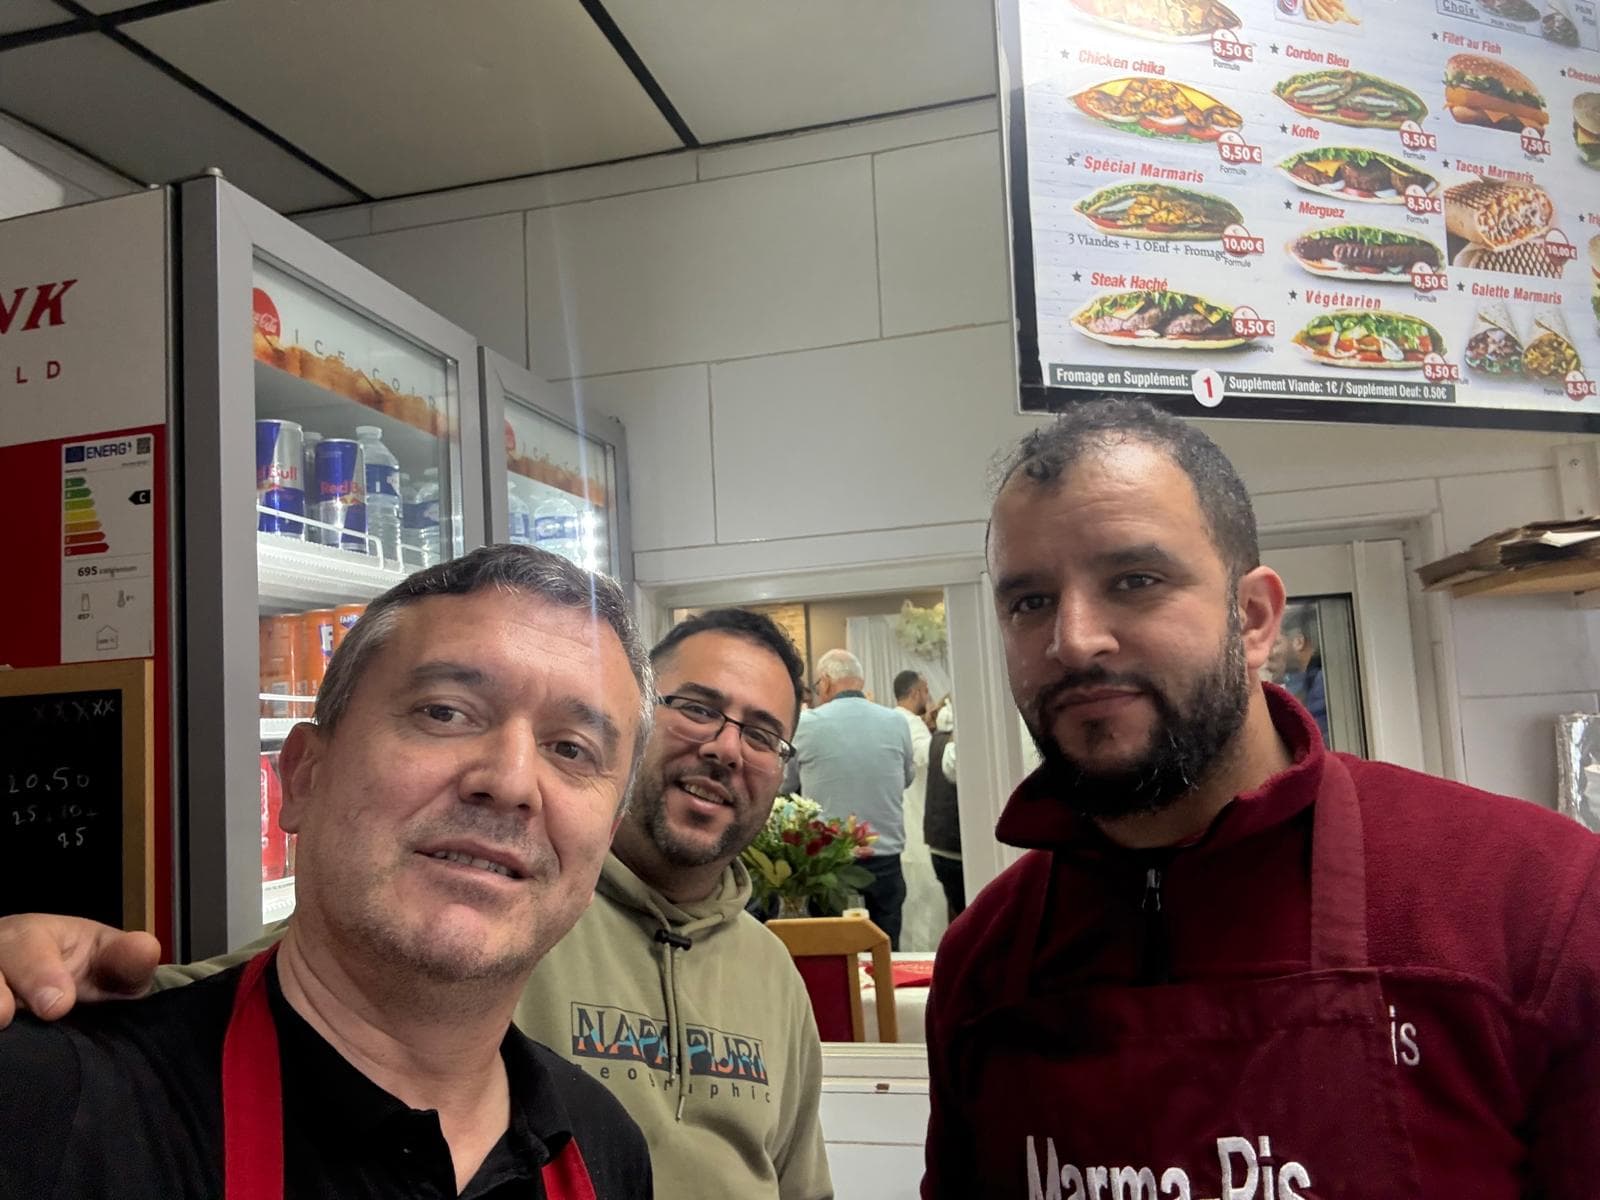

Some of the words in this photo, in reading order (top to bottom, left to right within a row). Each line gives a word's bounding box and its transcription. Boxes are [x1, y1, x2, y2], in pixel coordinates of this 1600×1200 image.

[1213, 41, 1242, 57] 8,50
[1286, 45, 1323, 63] Cordon
[1327, 52, 1349, 68] Bleu
[1079, 49, 1128, 69] Chicken
[1132, 60, 1165, 76] chika
[1402, 132, 1426, 148] 8,50
[1221, 144, 1251, 161] 8,50
[1084, 155, 1136, 176] Spécial
[1140, 163, 1205, 183] Marmaris
[1456, 159, 1485, 176] Tacos
[1488, 165, 1535, 184] Marmaris
[1299, 201, 1345, 219] Merguez
[1407, 198, 1432, 213] 8,50
[1068, 233, 1075, 246] 3
[1077, 234, 1120, 249] Viandes
[1123, 240, 1131, 248] +
[1184, 244, 1225, 260] Fromage
[1223, 238, 1254, 252] 10,00
[1090, 271, 1126, 288] Steak
[1130, 274, 1168, 292] Haché
[1414, 275, 1439, 289] 8,50
[1305, 289, 1382, 310] Végétarien
[1471, 282, 1510, 299] Galette
[1513, 286, 1563, 305] Marmaris
[1234, 319, 1264, 336] 8,50
[1424, 363, 1449, 379] 8,50
[1056, 368, 1104, 385] Fromage
[1108, 374, 1120, 384] en
[1123, 374, 1189, 388] Supplément:
[1203, 377, 1214, 398] 1
[1229, 376, 1286, 391] Supplément
[1289, 379, 1323, 392] Viande:
[1326, 381, 1337, 393] 1€
[1346, 384, 1397, 397] Supplément
[1423, 386, 1447, 399] 0.50€
